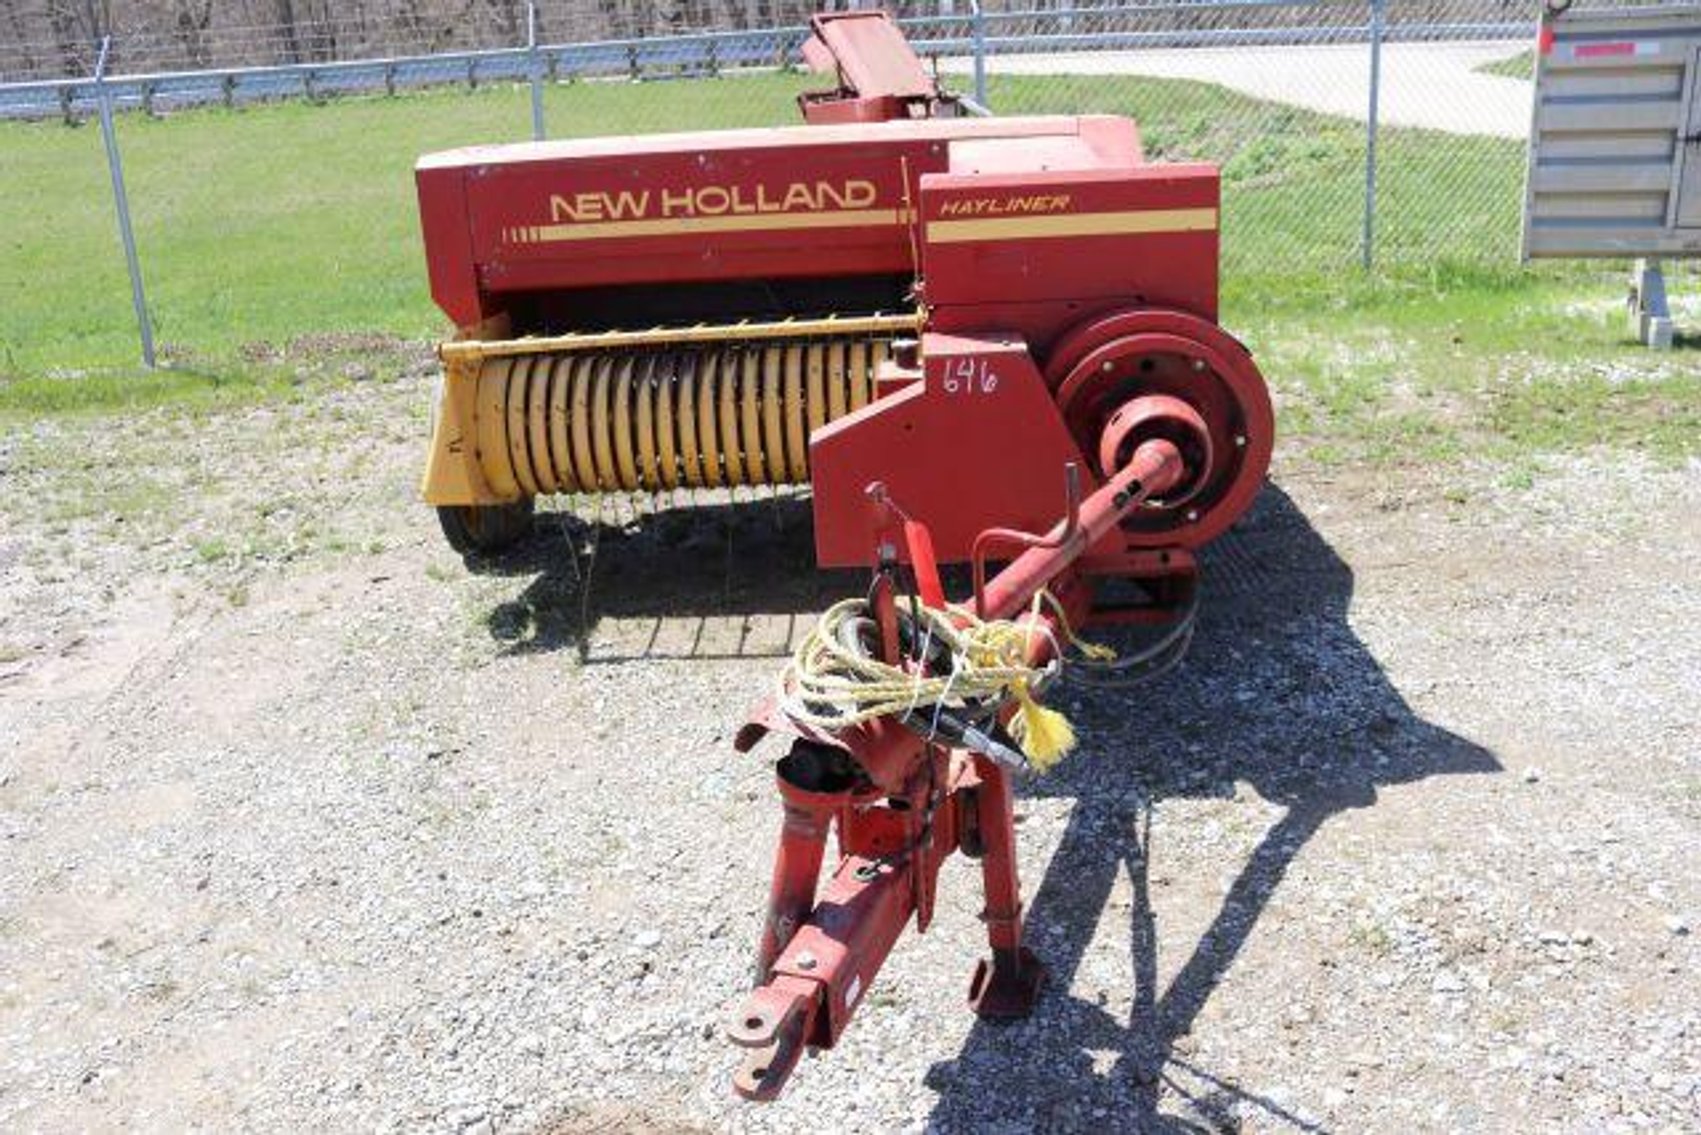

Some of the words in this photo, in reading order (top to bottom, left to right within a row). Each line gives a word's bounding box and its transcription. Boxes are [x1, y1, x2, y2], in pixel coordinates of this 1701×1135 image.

[551, 191, 649, 221] NEW
[662, 181, 876, 216] HOLLAND
[940, 195, 1071, 215] HAYLINER
[943, 358, 998, 393] 646
